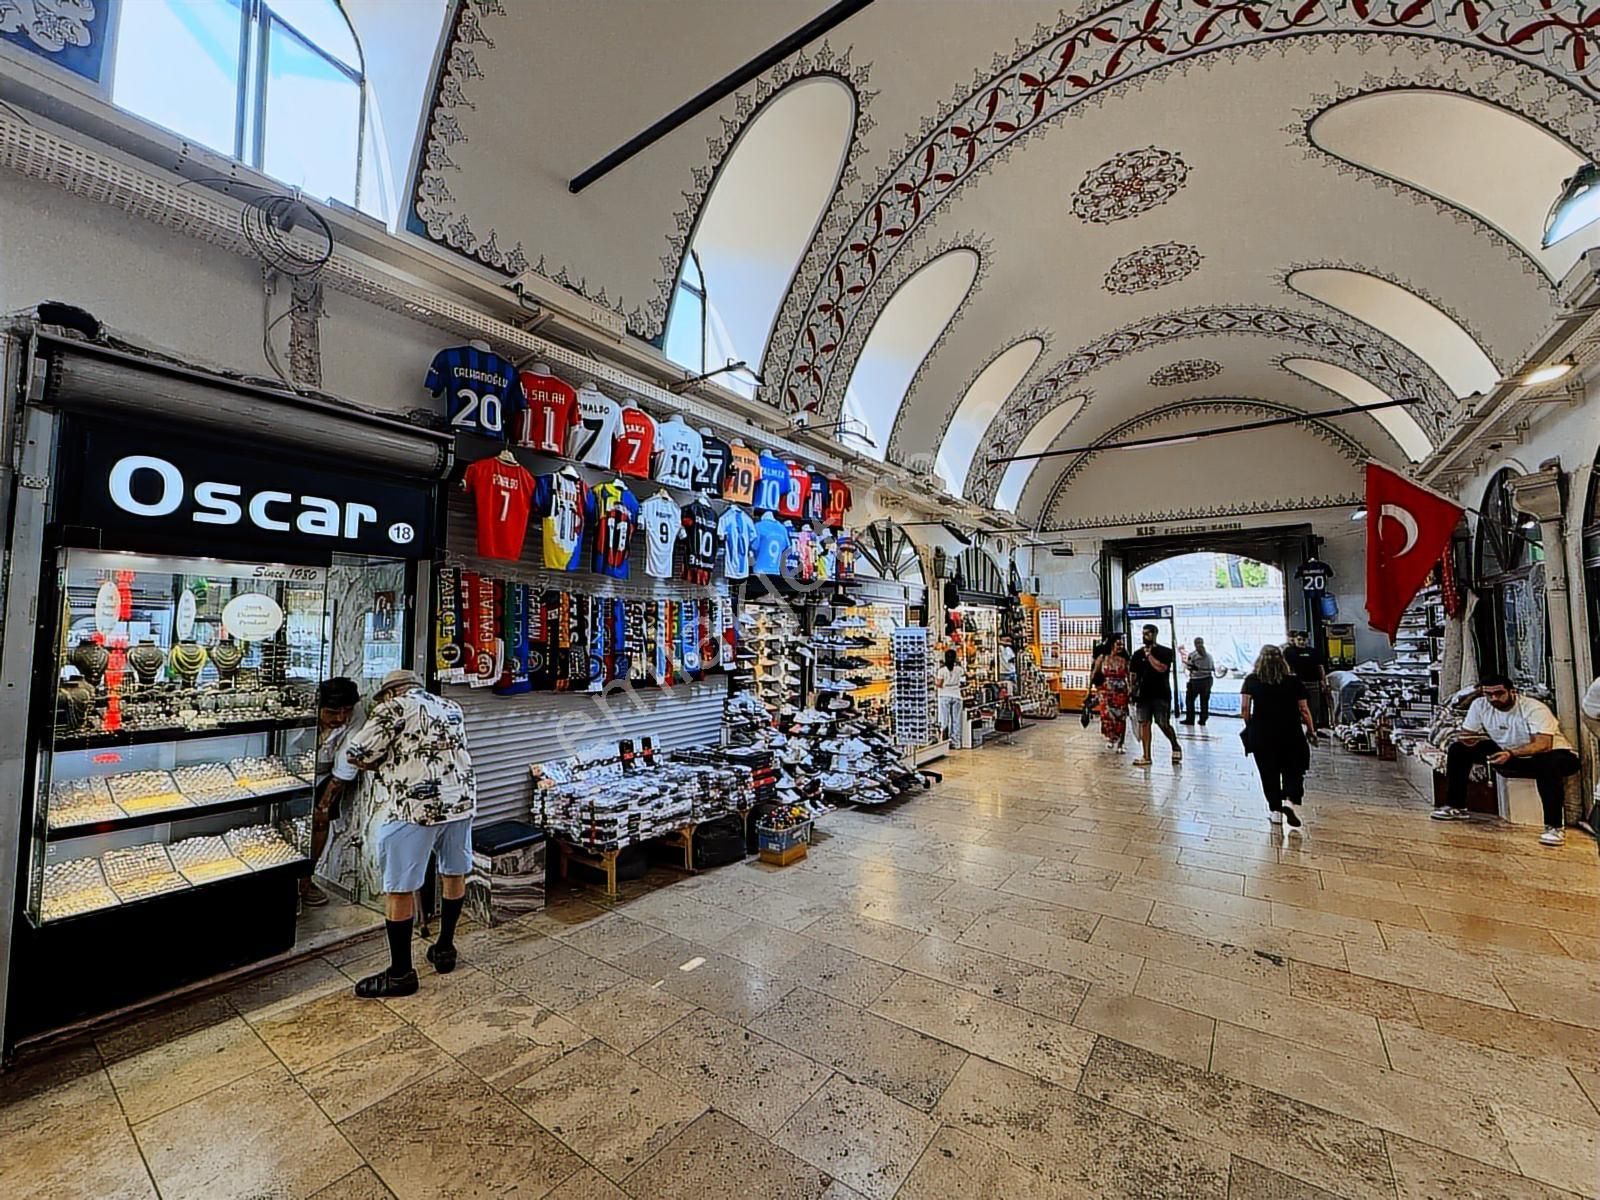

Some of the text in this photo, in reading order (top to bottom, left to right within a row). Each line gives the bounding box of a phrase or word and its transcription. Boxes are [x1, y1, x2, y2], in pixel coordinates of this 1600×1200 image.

[450, 388, 502, 432] 20
[531, 389, 566, 405] SALAH
[516, 406, 560, 451] 11
[575, 418, 604, 462] 7
[627, 439, 642, 465] 7
[671, 454, 690, 480] 10
[108, 455, 378, 540] Oscar
[500, 489, 511, 522] 7
[761, 480, 780, 511] 10
[394, 526, 411, 541] 18
[659, 522, 669, 544] 9
[252, 566, 286, 579] Since
[1303, 575, 1324, 590] 20
